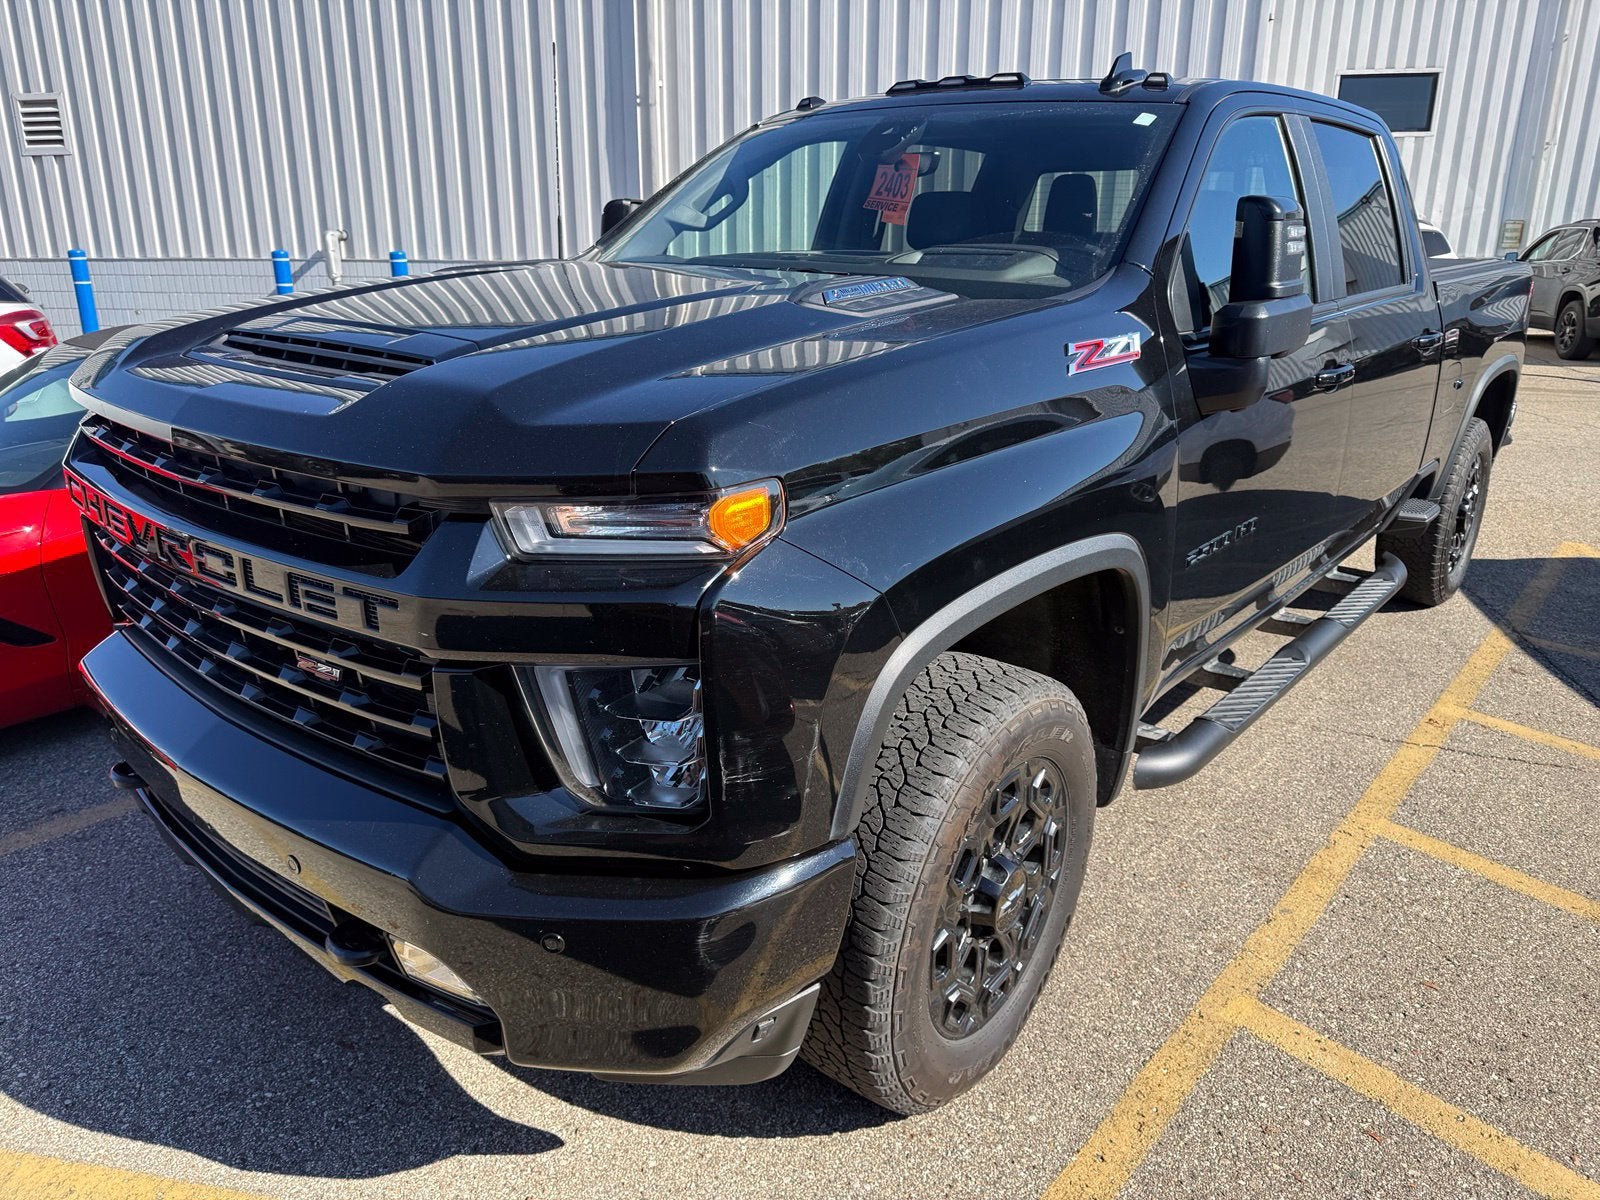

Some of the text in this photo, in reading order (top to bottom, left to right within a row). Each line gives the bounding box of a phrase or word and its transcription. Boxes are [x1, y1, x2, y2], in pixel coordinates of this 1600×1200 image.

[876, 172, 910, 199] 2403
[864, 200, 900, 212] SERVICE
[1064, 332, 1141, 376] Z71
[66, 475, 400, 633] CHEVROLET
[296, 655, 341, 682] Z71
